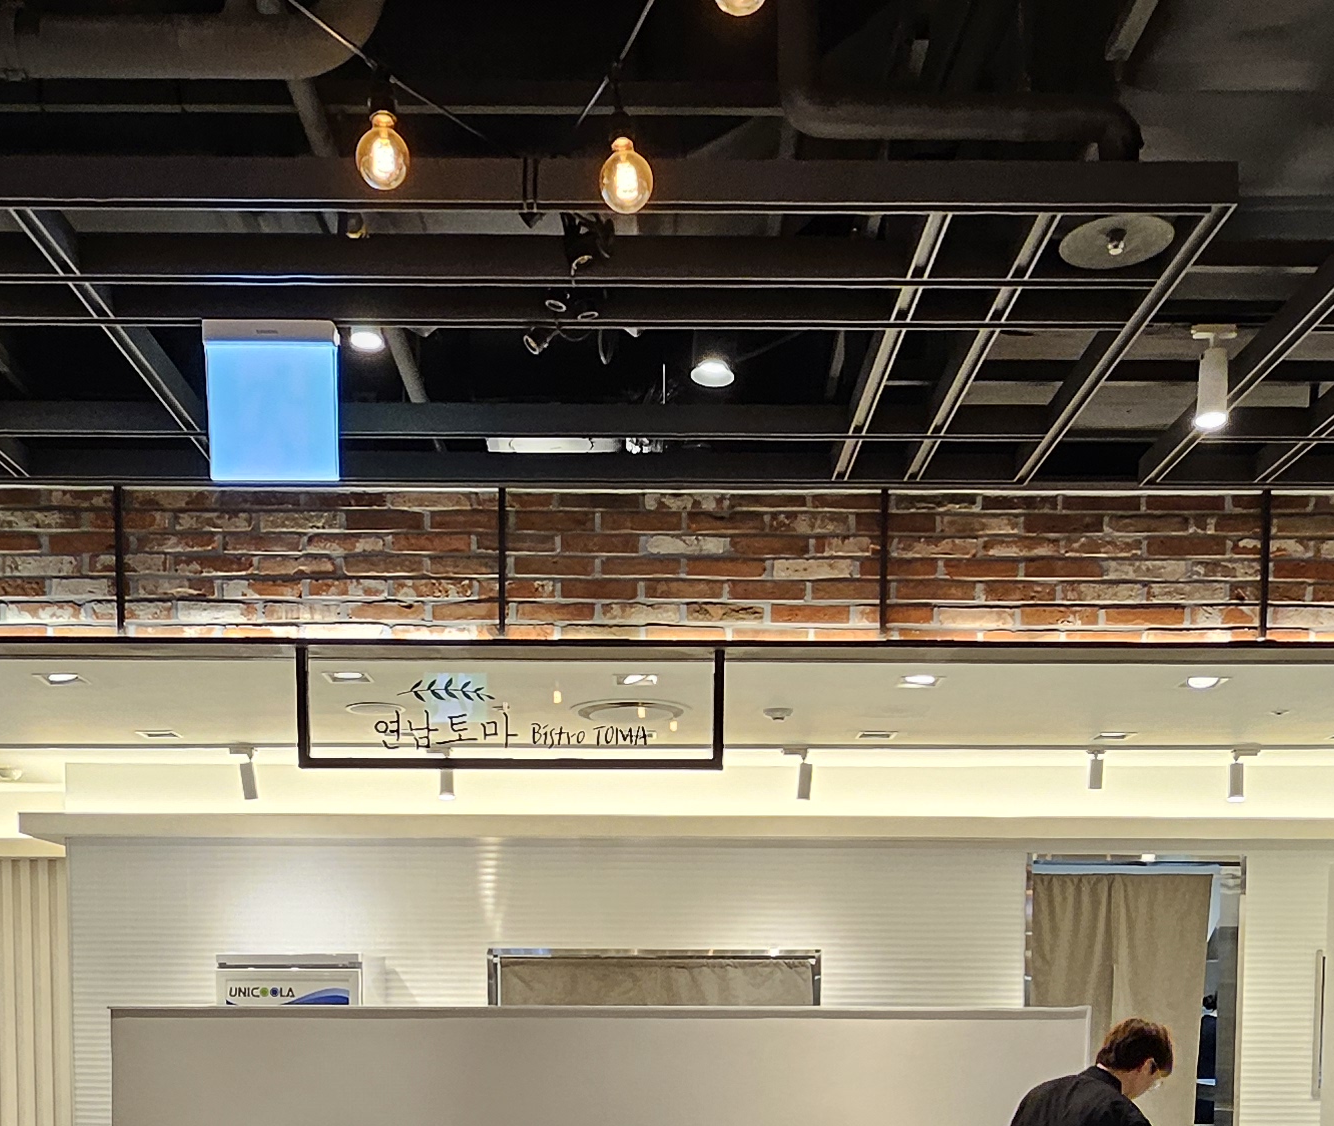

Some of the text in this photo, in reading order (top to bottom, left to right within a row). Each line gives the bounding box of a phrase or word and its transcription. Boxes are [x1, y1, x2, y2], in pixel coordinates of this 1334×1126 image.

[374, 710, 648, 749] 연남토마 Bistro TOMA
[228, 986, 295, 998] UNICOOLA
